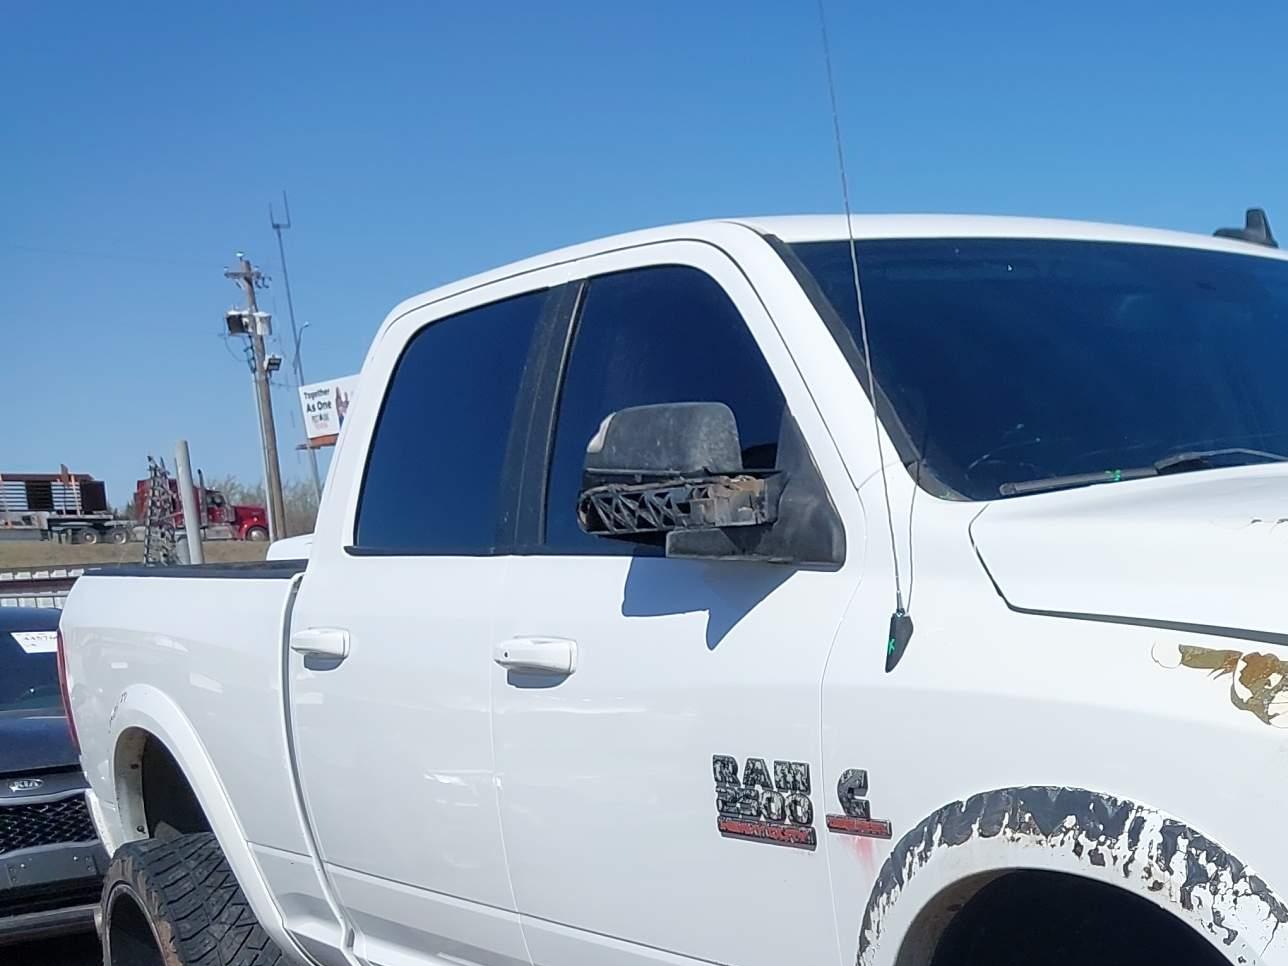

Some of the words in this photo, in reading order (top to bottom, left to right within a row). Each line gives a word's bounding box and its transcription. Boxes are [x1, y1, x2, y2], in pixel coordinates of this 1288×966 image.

[306, 403, 316, 413] As
[317, 401, 332, 411] One
[712, 754, 812, 796] RAM
[716, 787, 815, 827] 2500
